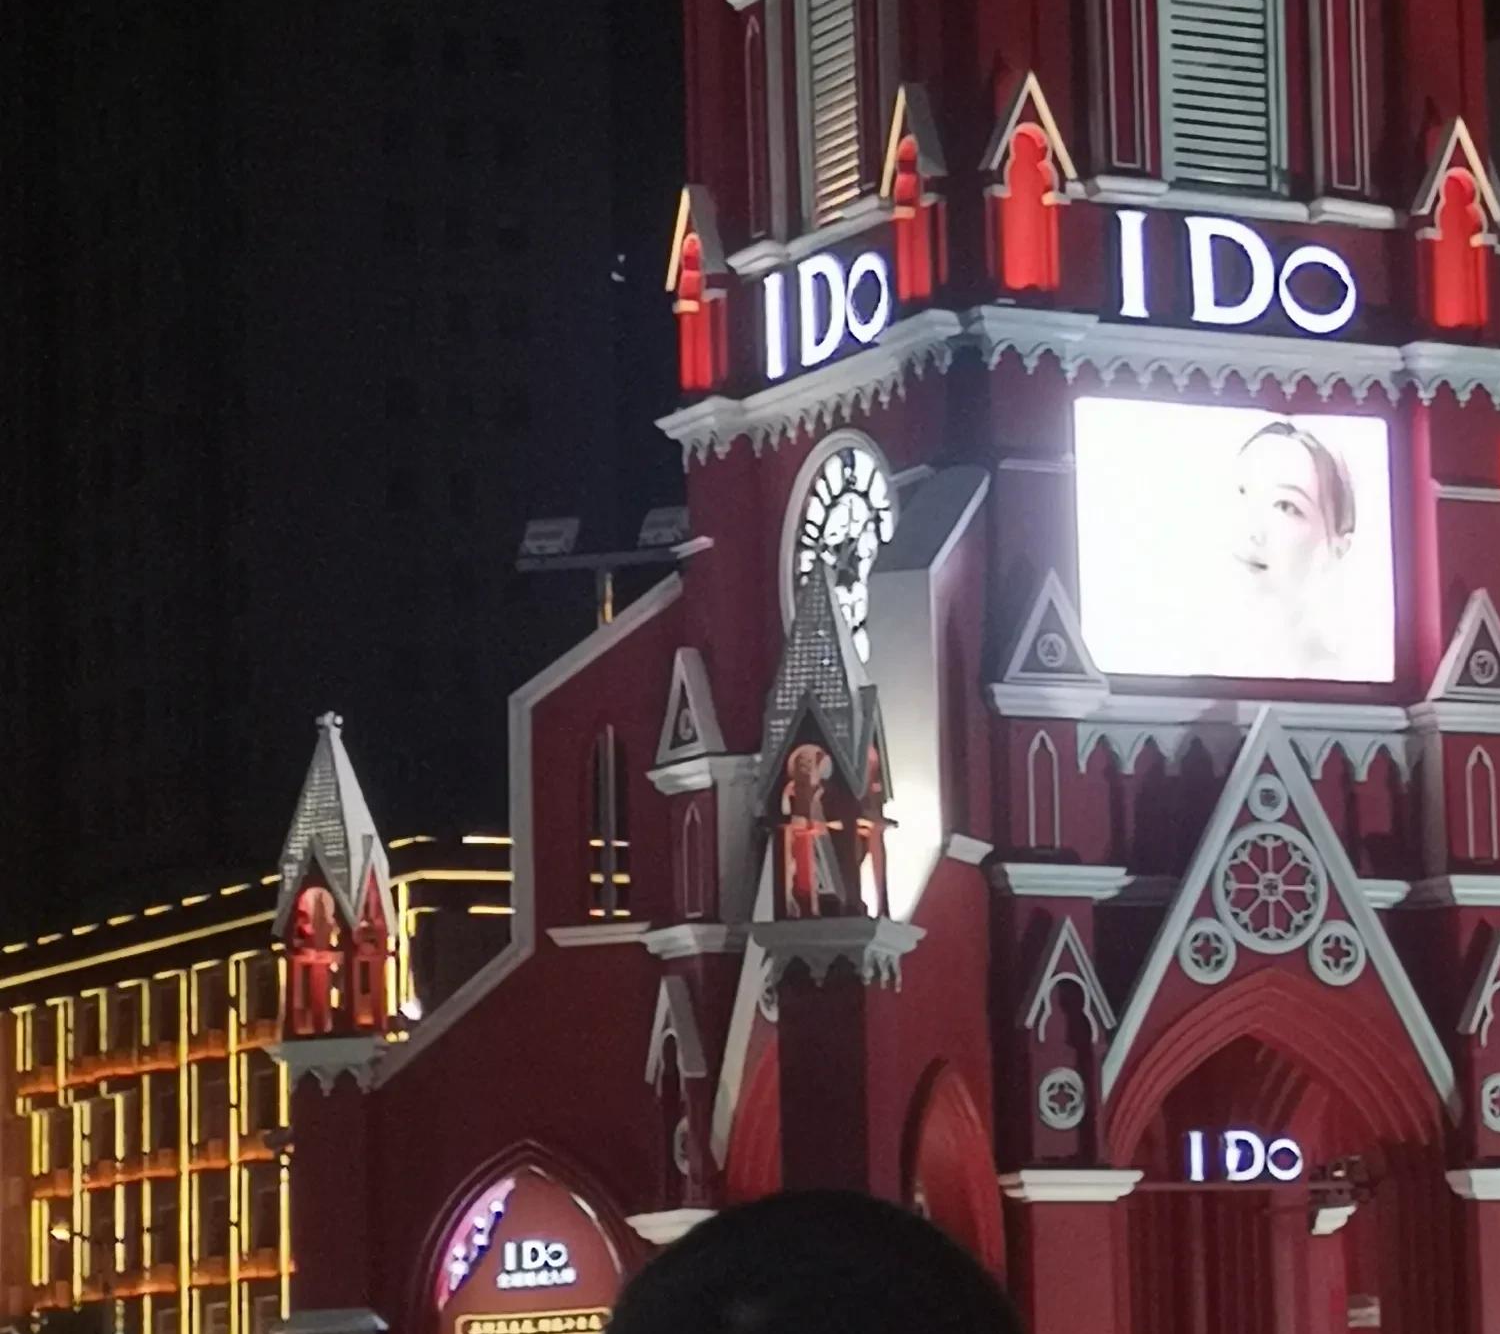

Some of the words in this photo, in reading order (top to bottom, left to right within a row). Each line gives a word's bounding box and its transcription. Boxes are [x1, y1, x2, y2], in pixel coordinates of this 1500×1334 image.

[1116, 209, 1149, 318] I
[763, 272, 787, 380] I
[1188, 1130, 1205, 1182] I
[504, 1241, 517, 1271] I
